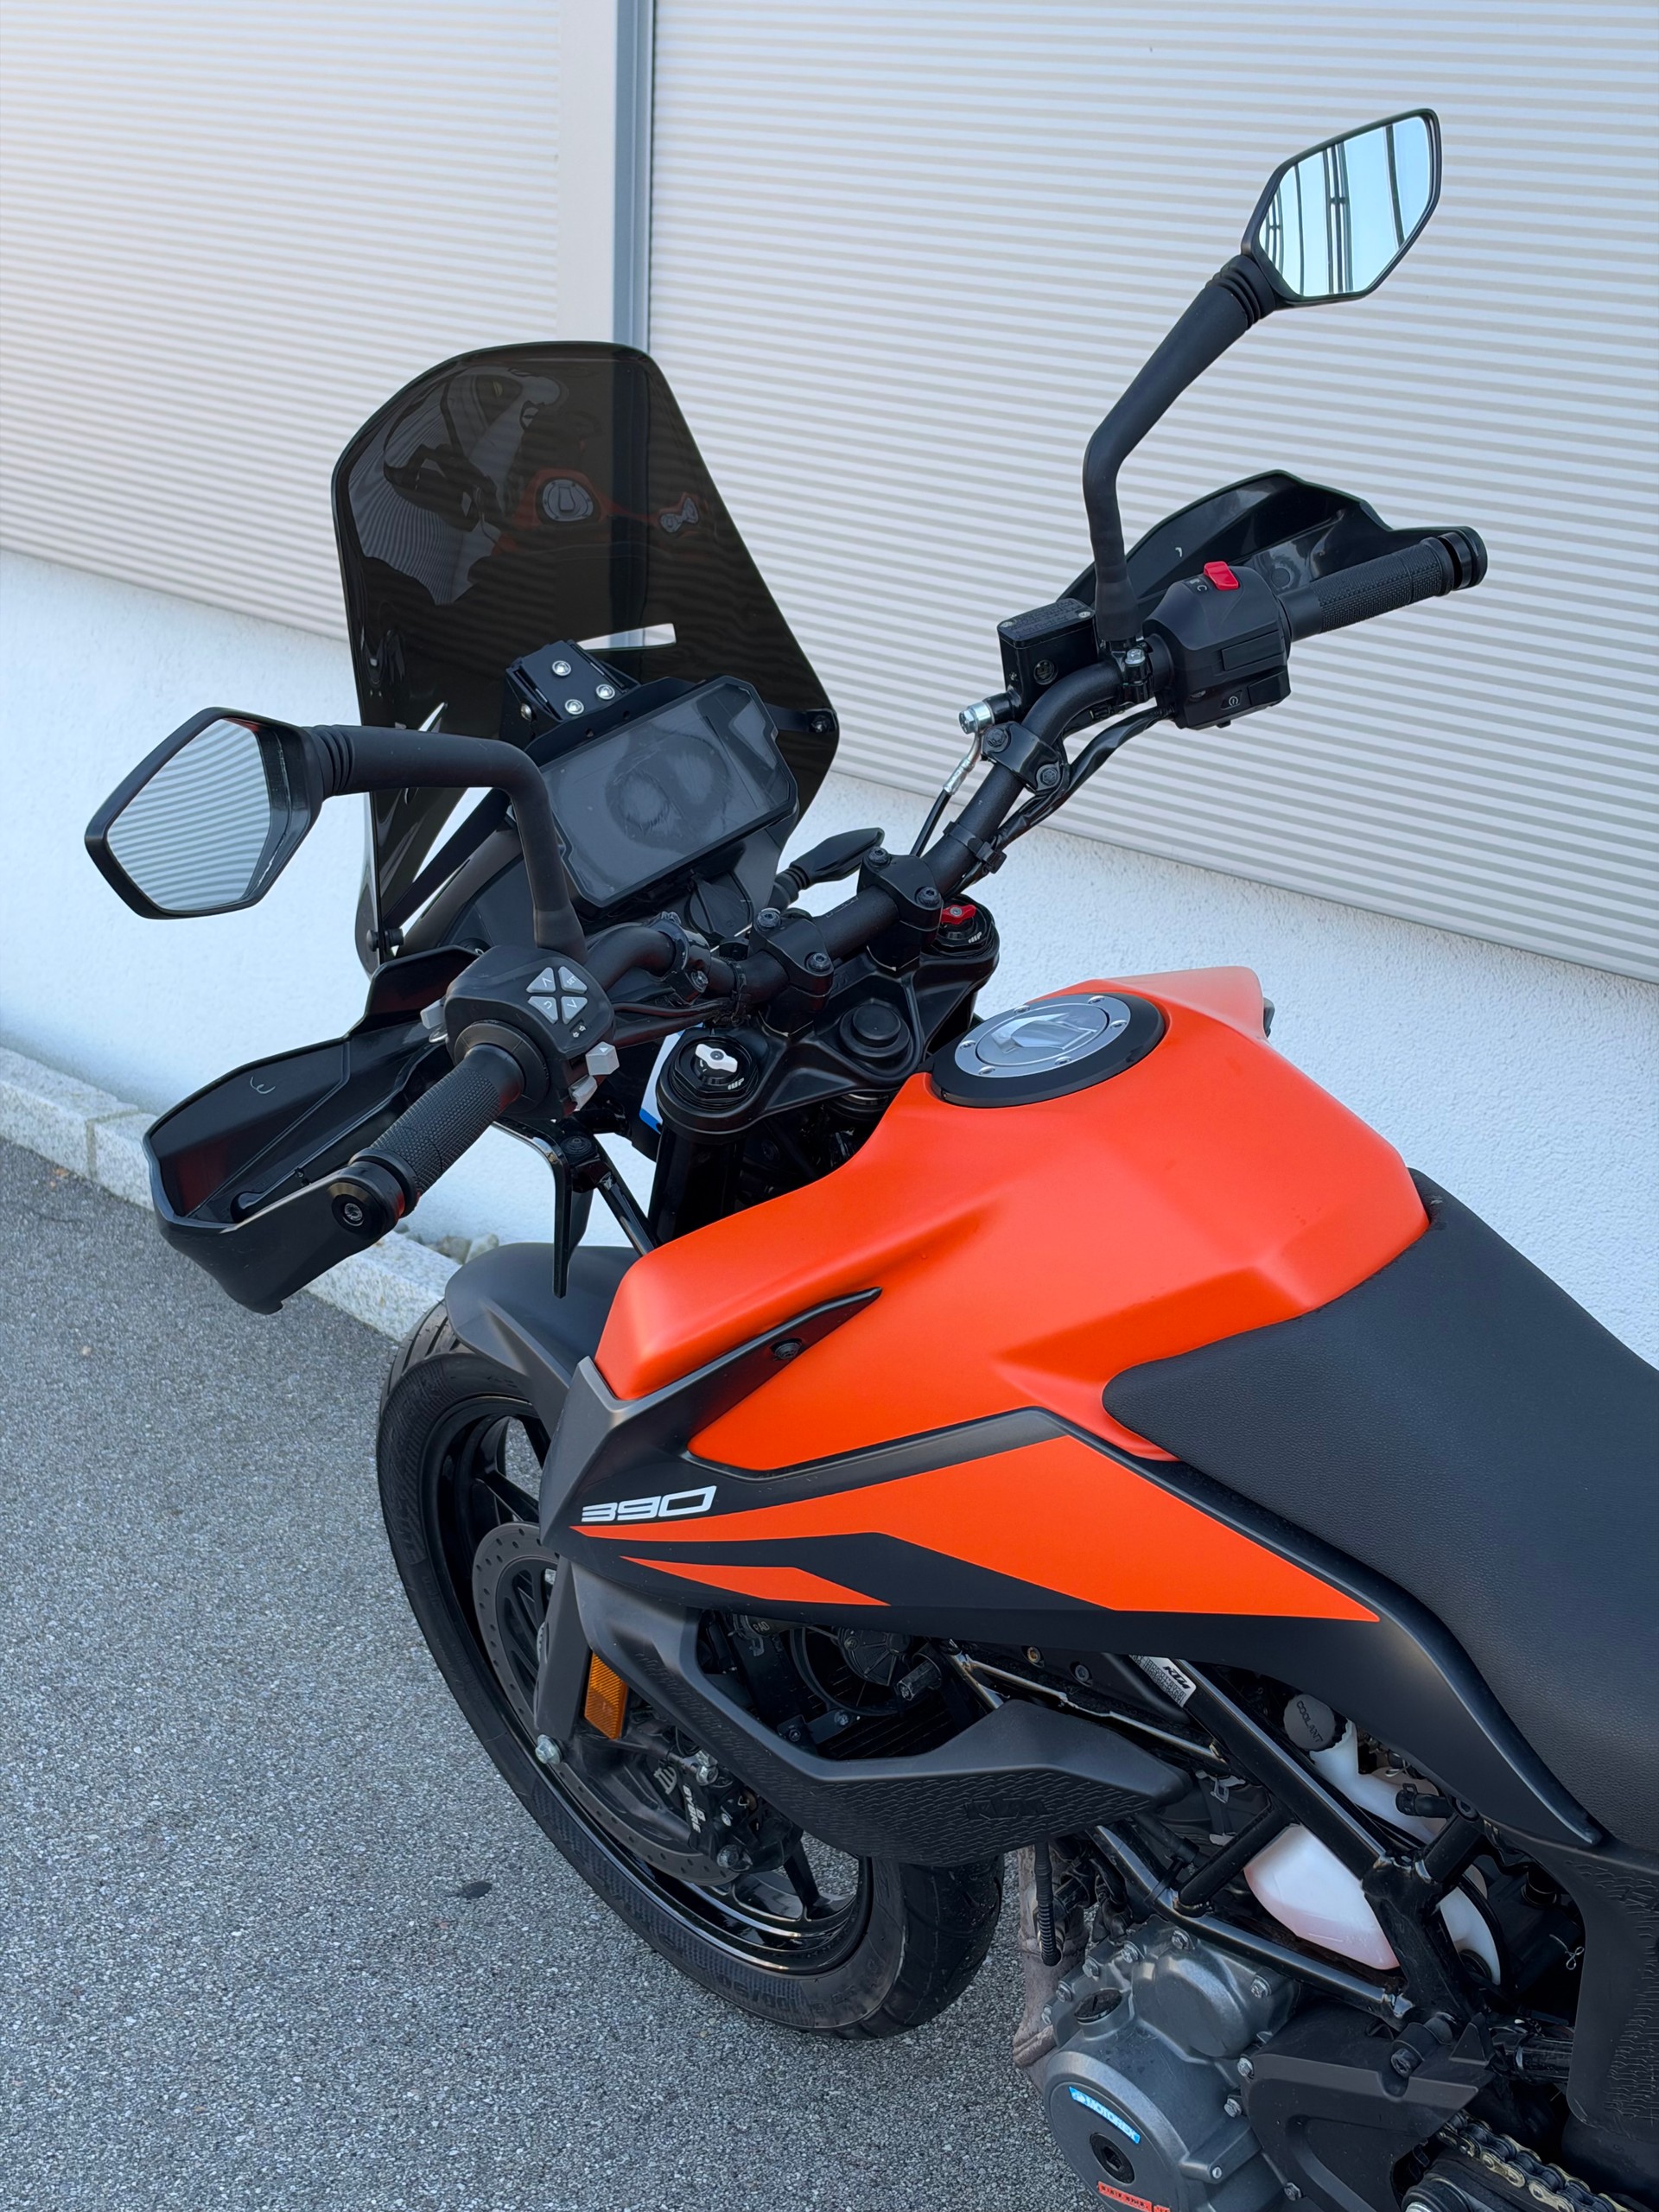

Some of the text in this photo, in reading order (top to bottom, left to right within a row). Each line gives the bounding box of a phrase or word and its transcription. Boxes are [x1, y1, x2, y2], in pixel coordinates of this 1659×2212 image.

[581, 1484, 718, 1522] 390
[1162, 1665, 1192, 1689] KTM
[1296, 1700, 1324, 1743] COOLANT
[682, 1784, 702, 1834] BYBRE
